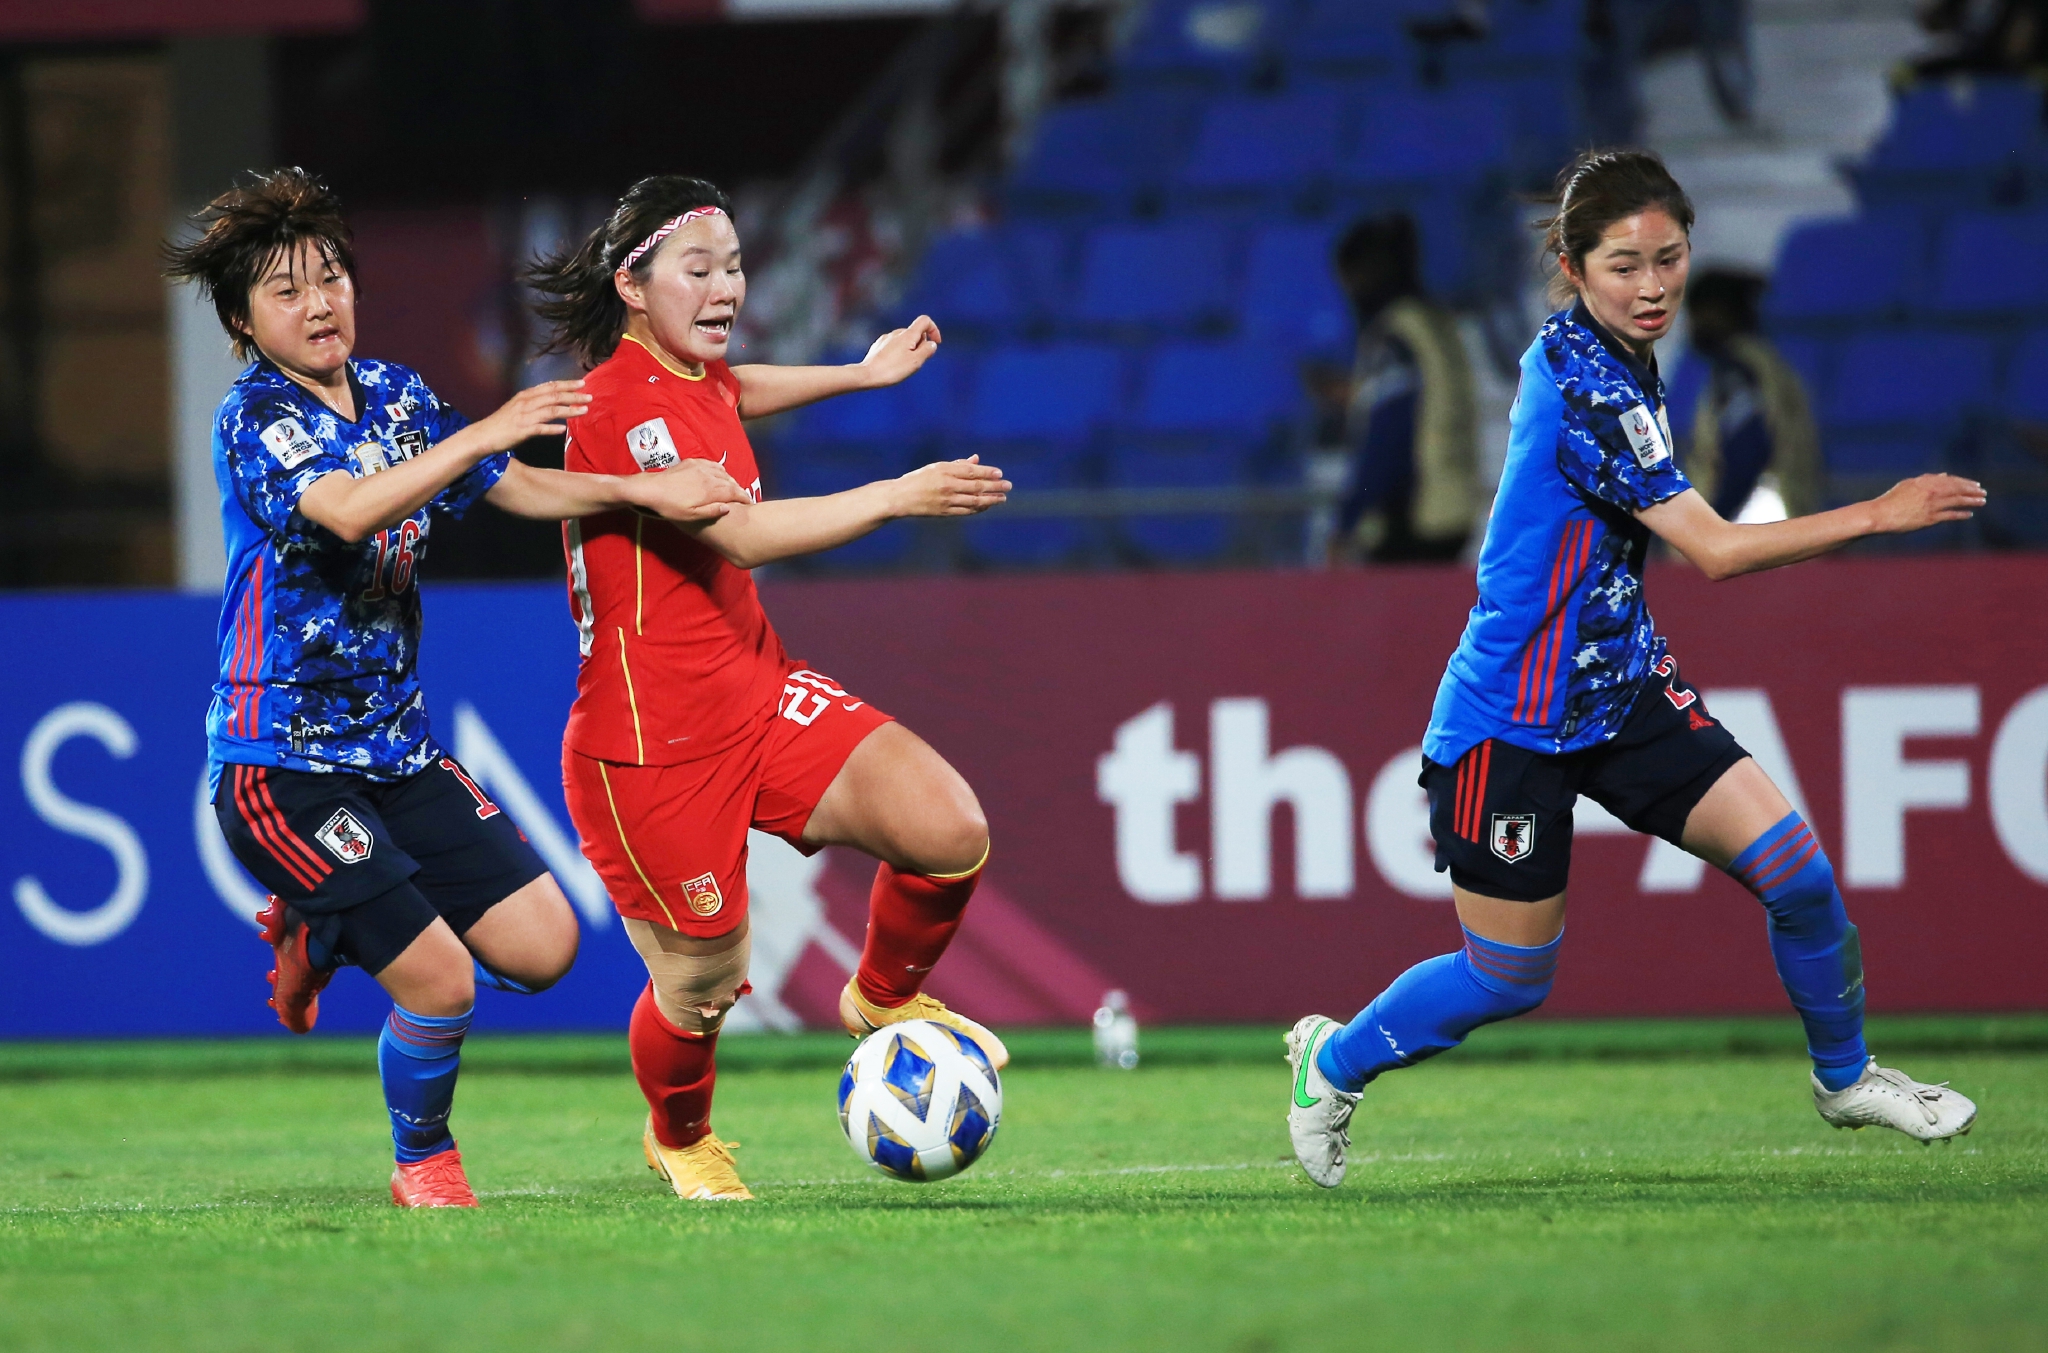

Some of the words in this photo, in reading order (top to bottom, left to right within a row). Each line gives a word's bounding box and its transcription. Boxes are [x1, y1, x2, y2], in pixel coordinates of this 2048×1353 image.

[363, 519, 420, 601] 16
[1653, 655, 1697, 710] 2
[439, 758, 500, 820] 1
[686, 877, 712, 892] CFA
